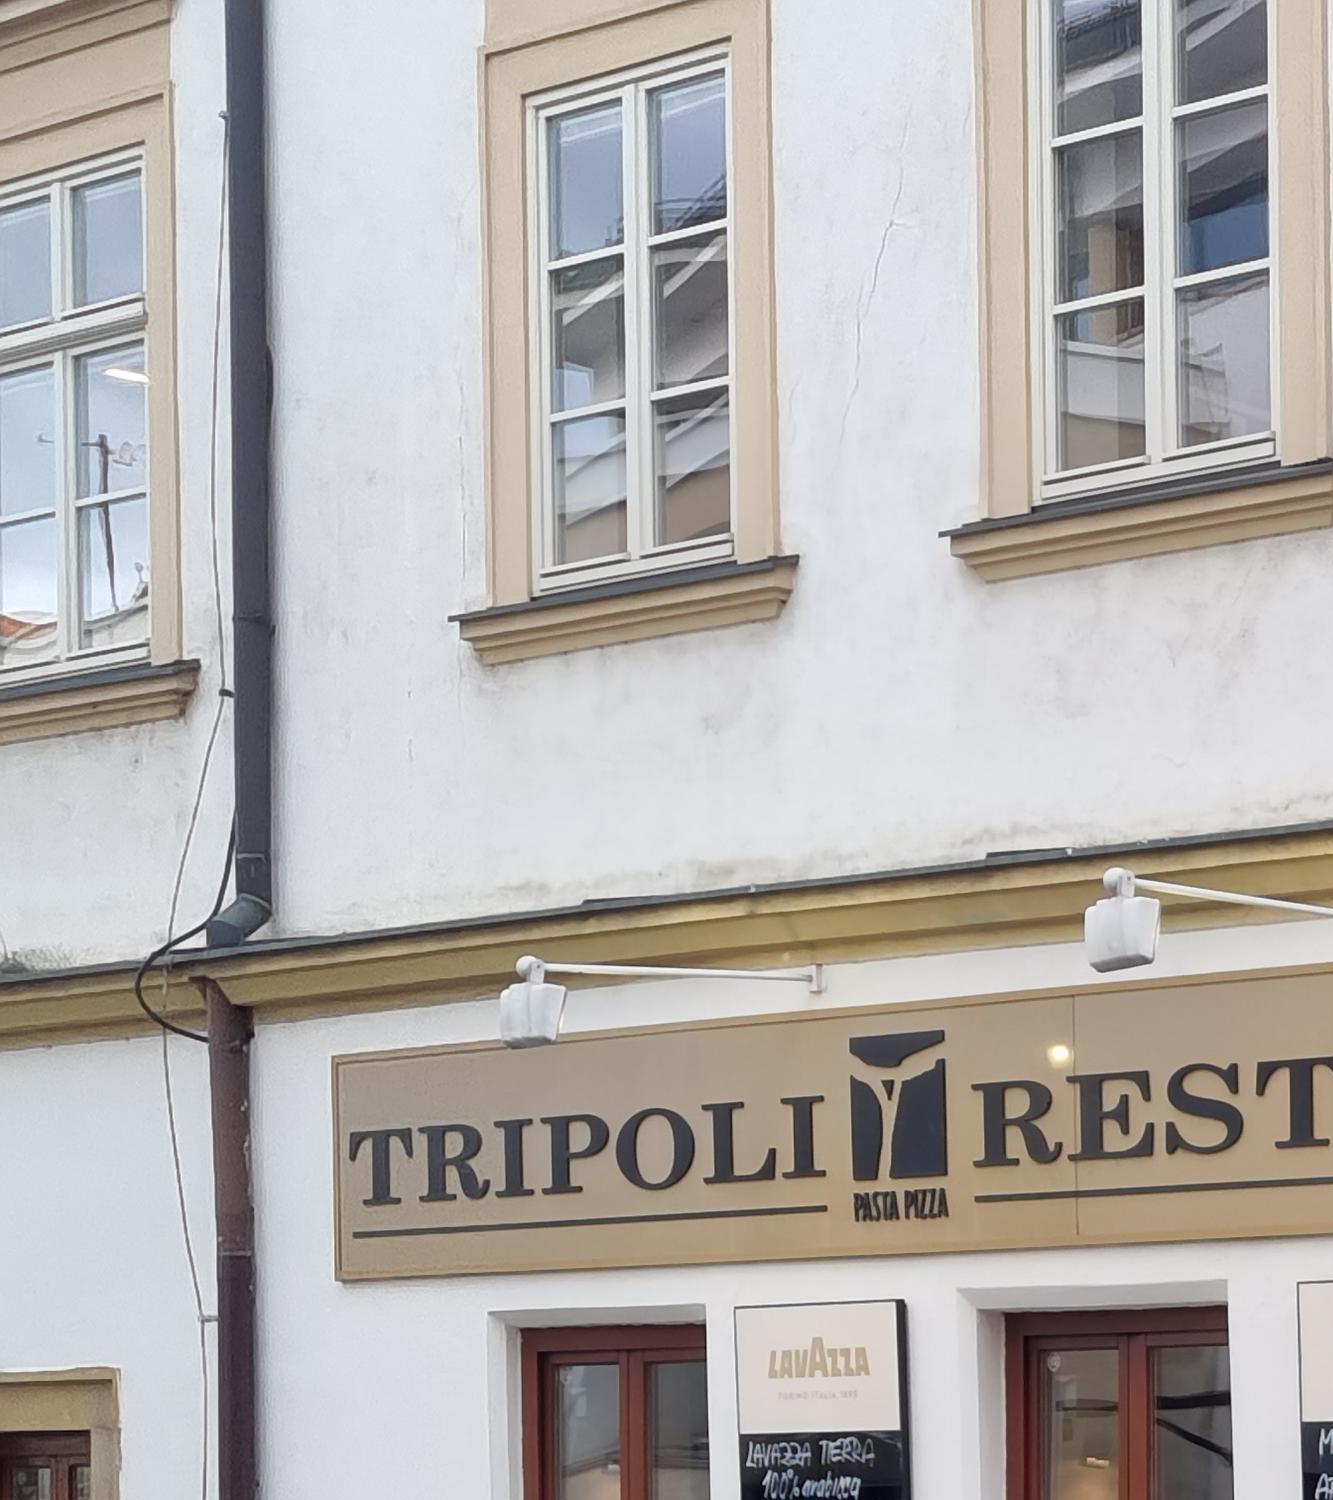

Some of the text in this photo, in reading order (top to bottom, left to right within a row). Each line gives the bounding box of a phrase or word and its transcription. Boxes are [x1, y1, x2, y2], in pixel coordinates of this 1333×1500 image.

[349, 1094, 826, 1206] TRIPOLI
[853, 1186, 949, 1223] PASTA PIZZA
[768, 1337, 870, 1379] LAVAZZA
[746, 1437, 875, 1467] LAVAZZA TIERRA
